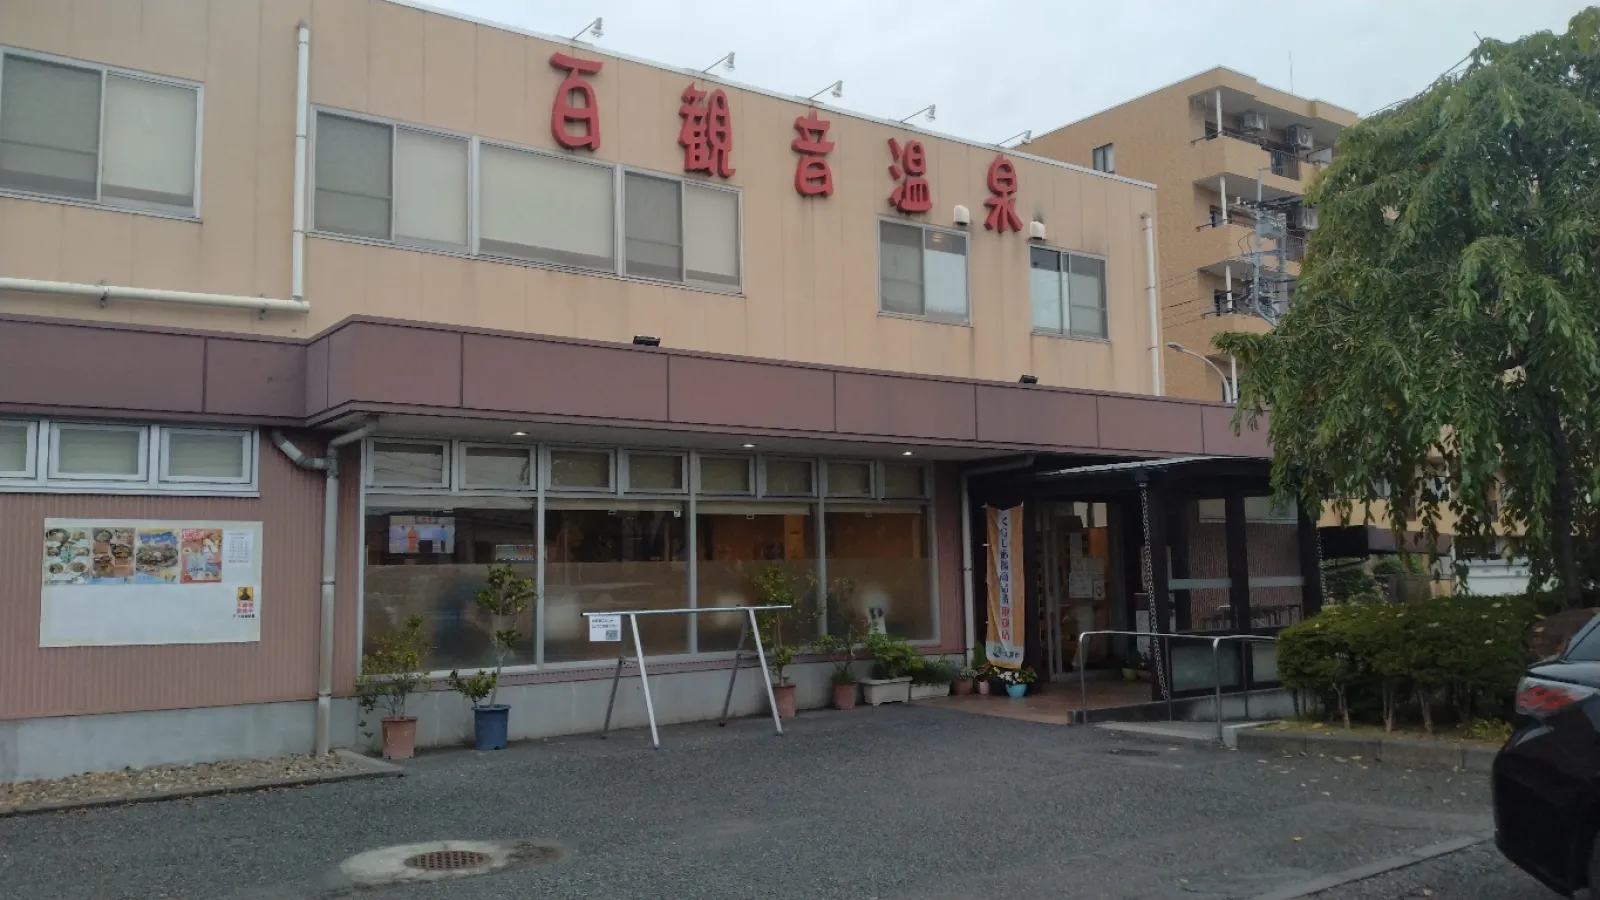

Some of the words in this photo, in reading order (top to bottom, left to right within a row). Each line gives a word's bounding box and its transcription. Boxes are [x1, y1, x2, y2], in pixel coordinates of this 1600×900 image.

[549, 51, 1023, 234] 百観音温泉
